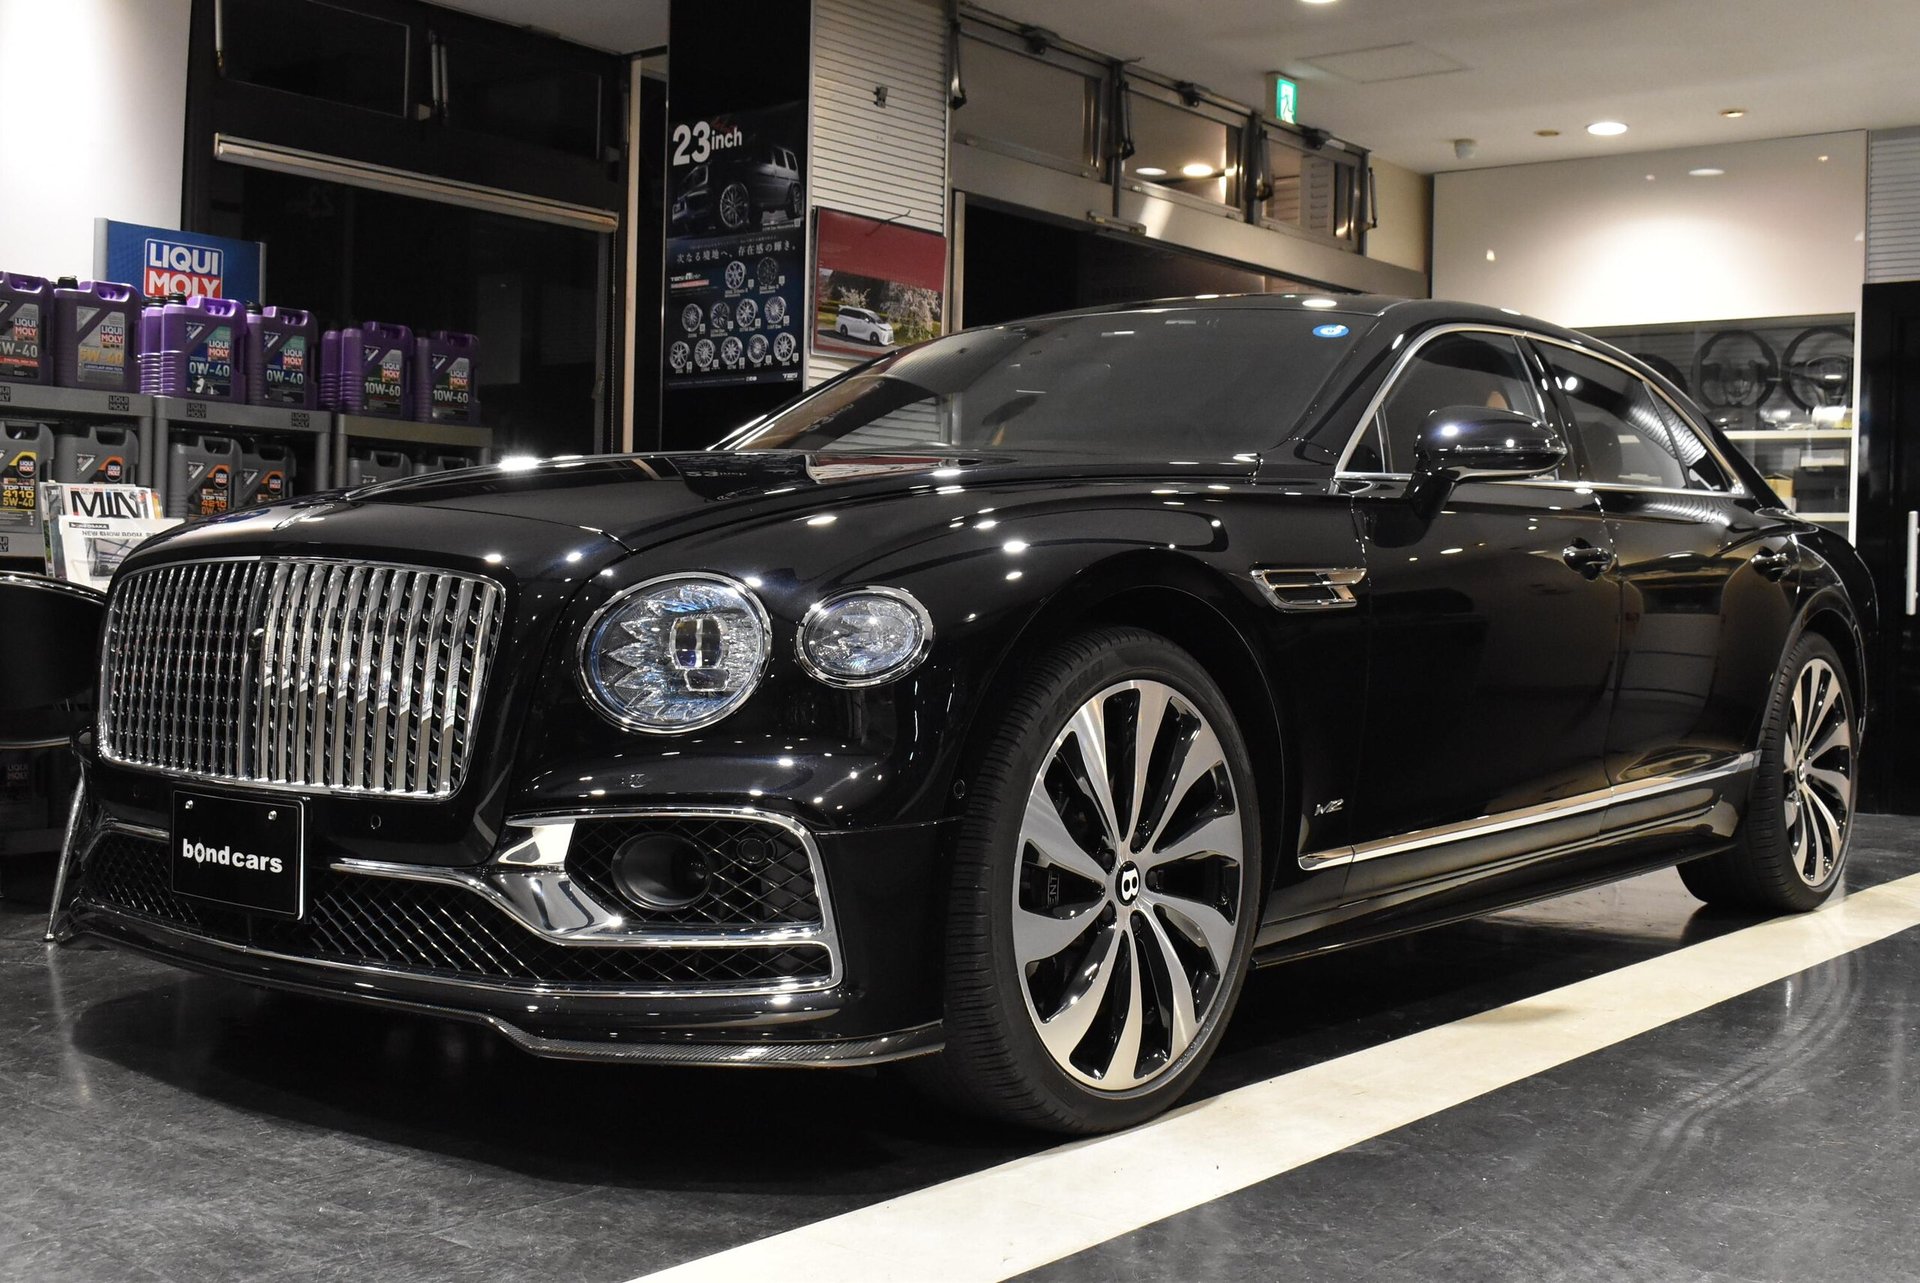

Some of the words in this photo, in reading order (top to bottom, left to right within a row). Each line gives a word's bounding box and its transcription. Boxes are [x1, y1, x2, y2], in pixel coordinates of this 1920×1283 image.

[149, 241, 219, 275] LIQUI
[149, 271, 220, 298] MOLY
[14, 318, 38, 327] LIQUI
[14, 327, 38, 336] MOLY
[101, 325, 124, 334] LIQUI
[101, 334, 123, 343] MOLY
[208, 340, 229, 349] LIQUI
[208, 348, 230, 357] MOLY
[283, 349, 303, 357] LIQUI
[283, 356, 304, 366] MOLY
[189, 361, 230, 377] 0W-40
[266, 369, 304, 384] 0W-40
[364, 382, 401, 397] 10W-60
[432, 389, 469, 404] 10W-60
[3, 490, 34, 498] 4110
[3, 498, 34, 507] 5W-40
[182, 837, 283, 874] bondcars
